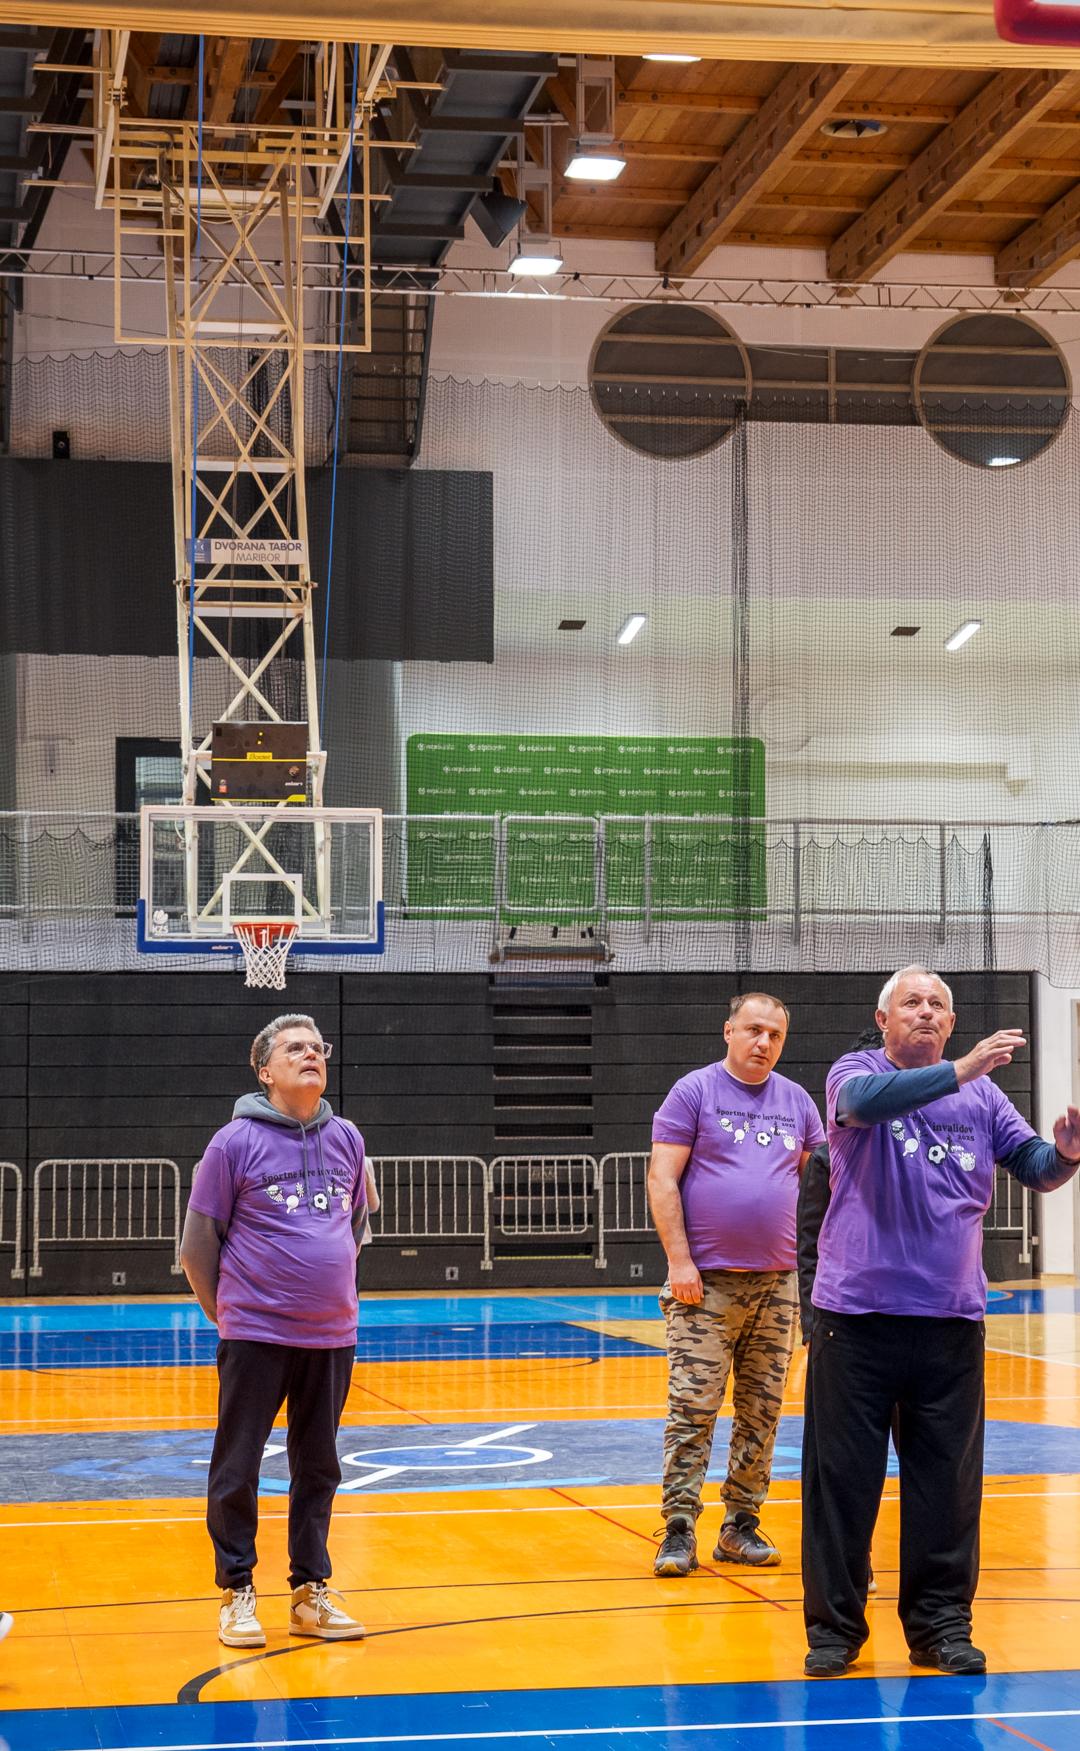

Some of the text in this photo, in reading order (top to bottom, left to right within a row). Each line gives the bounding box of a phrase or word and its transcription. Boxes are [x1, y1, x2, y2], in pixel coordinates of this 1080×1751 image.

[214, 541, 302, 552] DVORANA TABOR
[236, 553, 280, 562] MARIBOR
[716, 1105, 745, 1117] Športne
[747, 1111, 761, 1120] igre
[932, 1122, 973, 1134] invalidov
[957, 1134, 975, 1142] 2025
[262, 1172, 297, 1184] Športne
